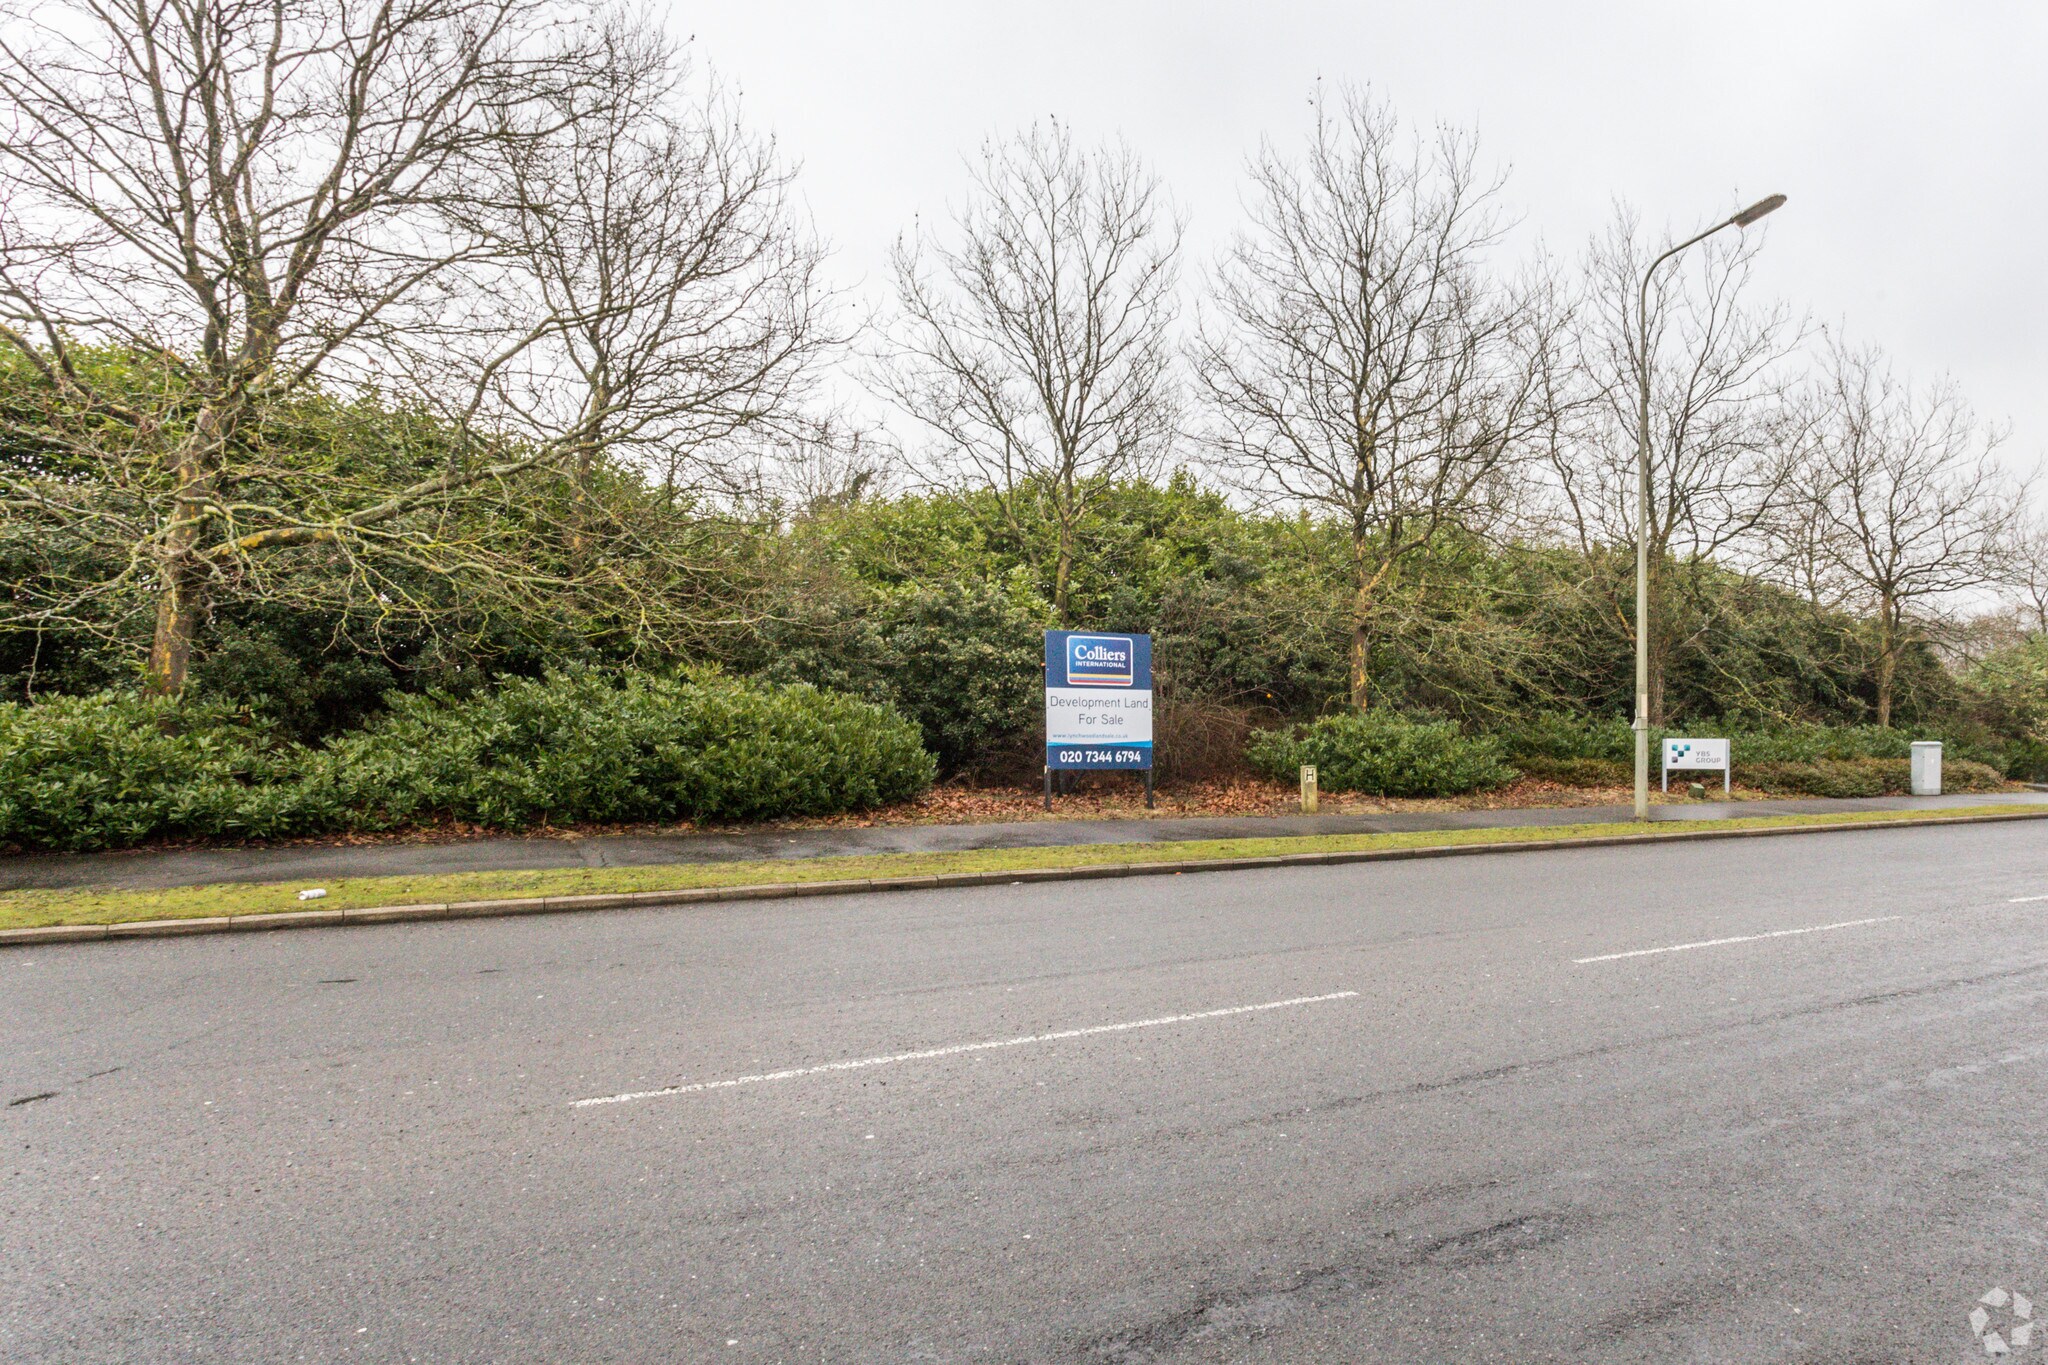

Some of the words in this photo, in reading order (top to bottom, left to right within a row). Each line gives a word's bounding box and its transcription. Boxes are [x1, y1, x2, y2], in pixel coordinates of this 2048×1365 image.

[1074, 645, 1126, 661] Colliers
[1050, 696, 1120, 710] Development
[1124, 697, 1148, 708] Land
[1078, 714, 1096, 724] For
[1101, 714, 1124, 725] Sale
[1060, 750, 1082, 763] 020
[1085, 750, 1112, 763] 7344
[1115, 750, 1142, 763] 6794
[1306, 769, 1314, 780] H
